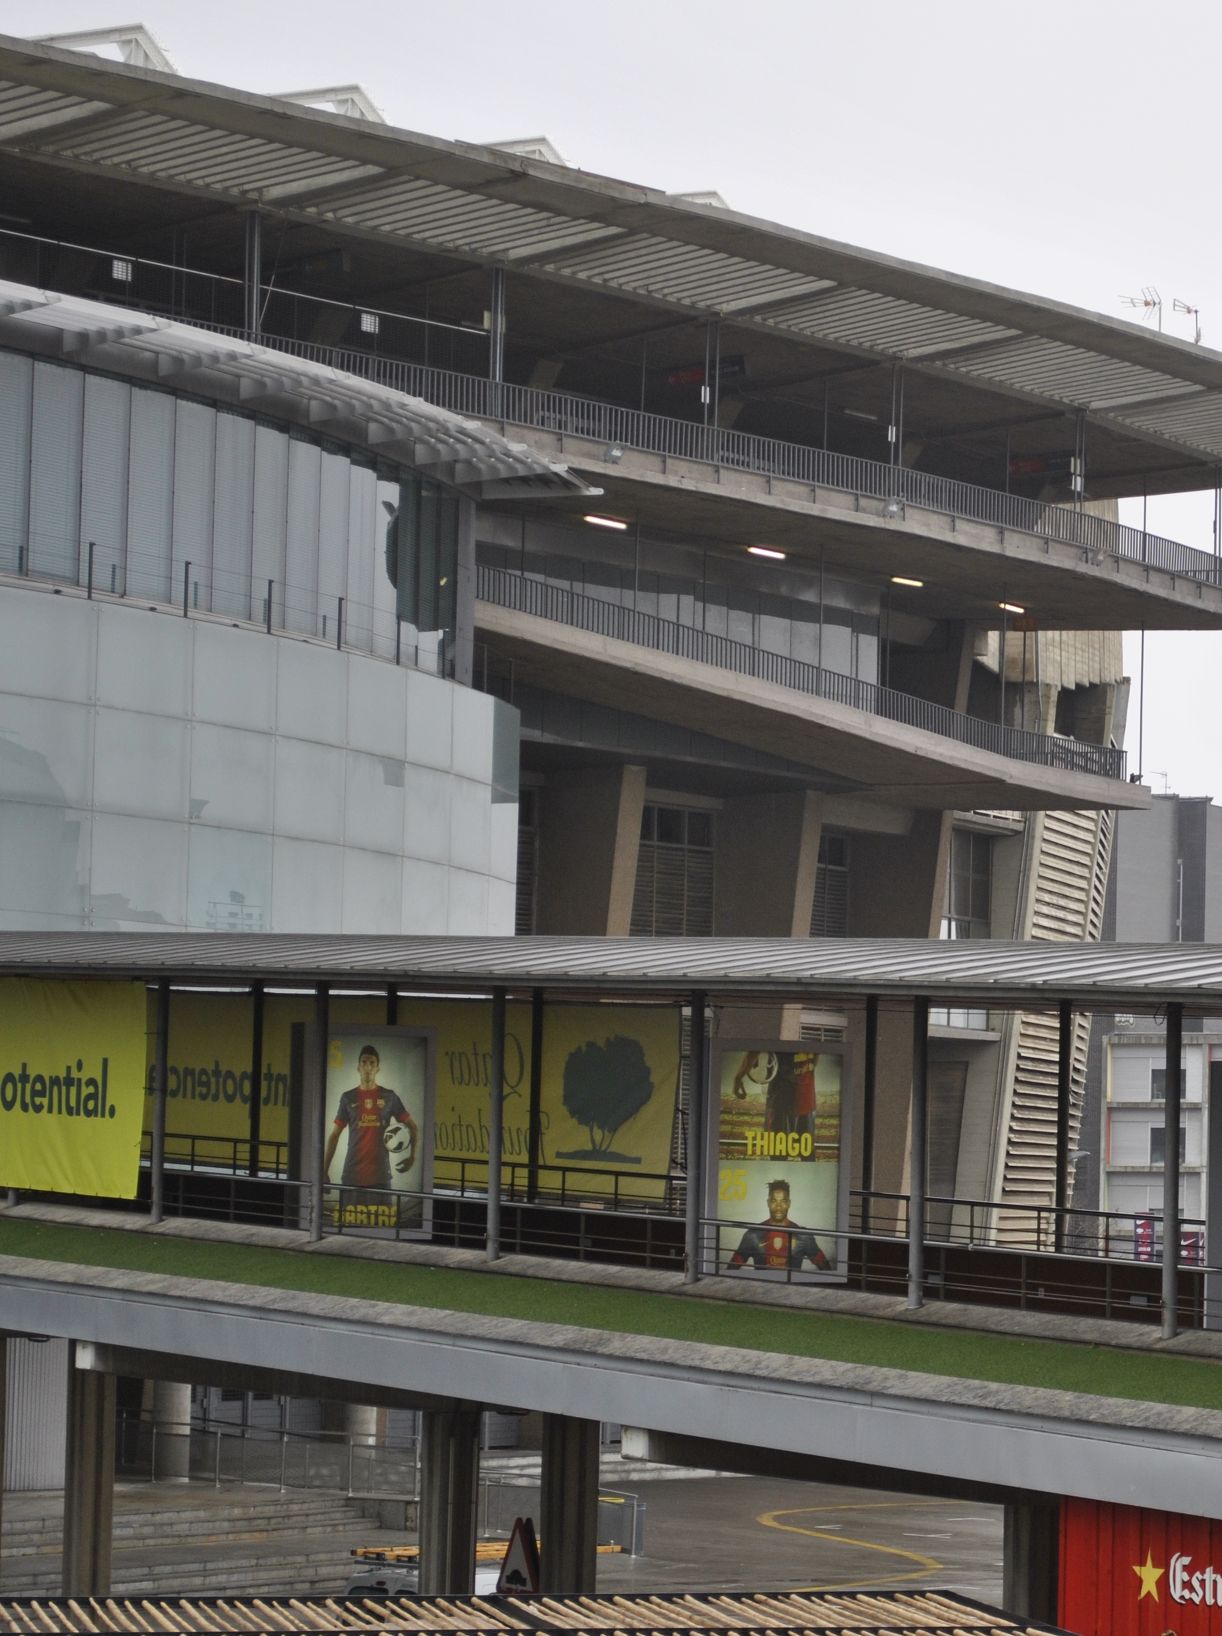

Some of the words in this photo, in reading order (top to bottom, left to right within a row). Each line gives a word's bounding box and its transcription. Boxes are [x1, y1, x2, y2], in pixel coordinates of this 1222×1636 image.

[0, 1057, 116, 1120] otential.
[745, 1131, 812, 1157] THIAGO
[719, 1168, 748, 1201] 25
